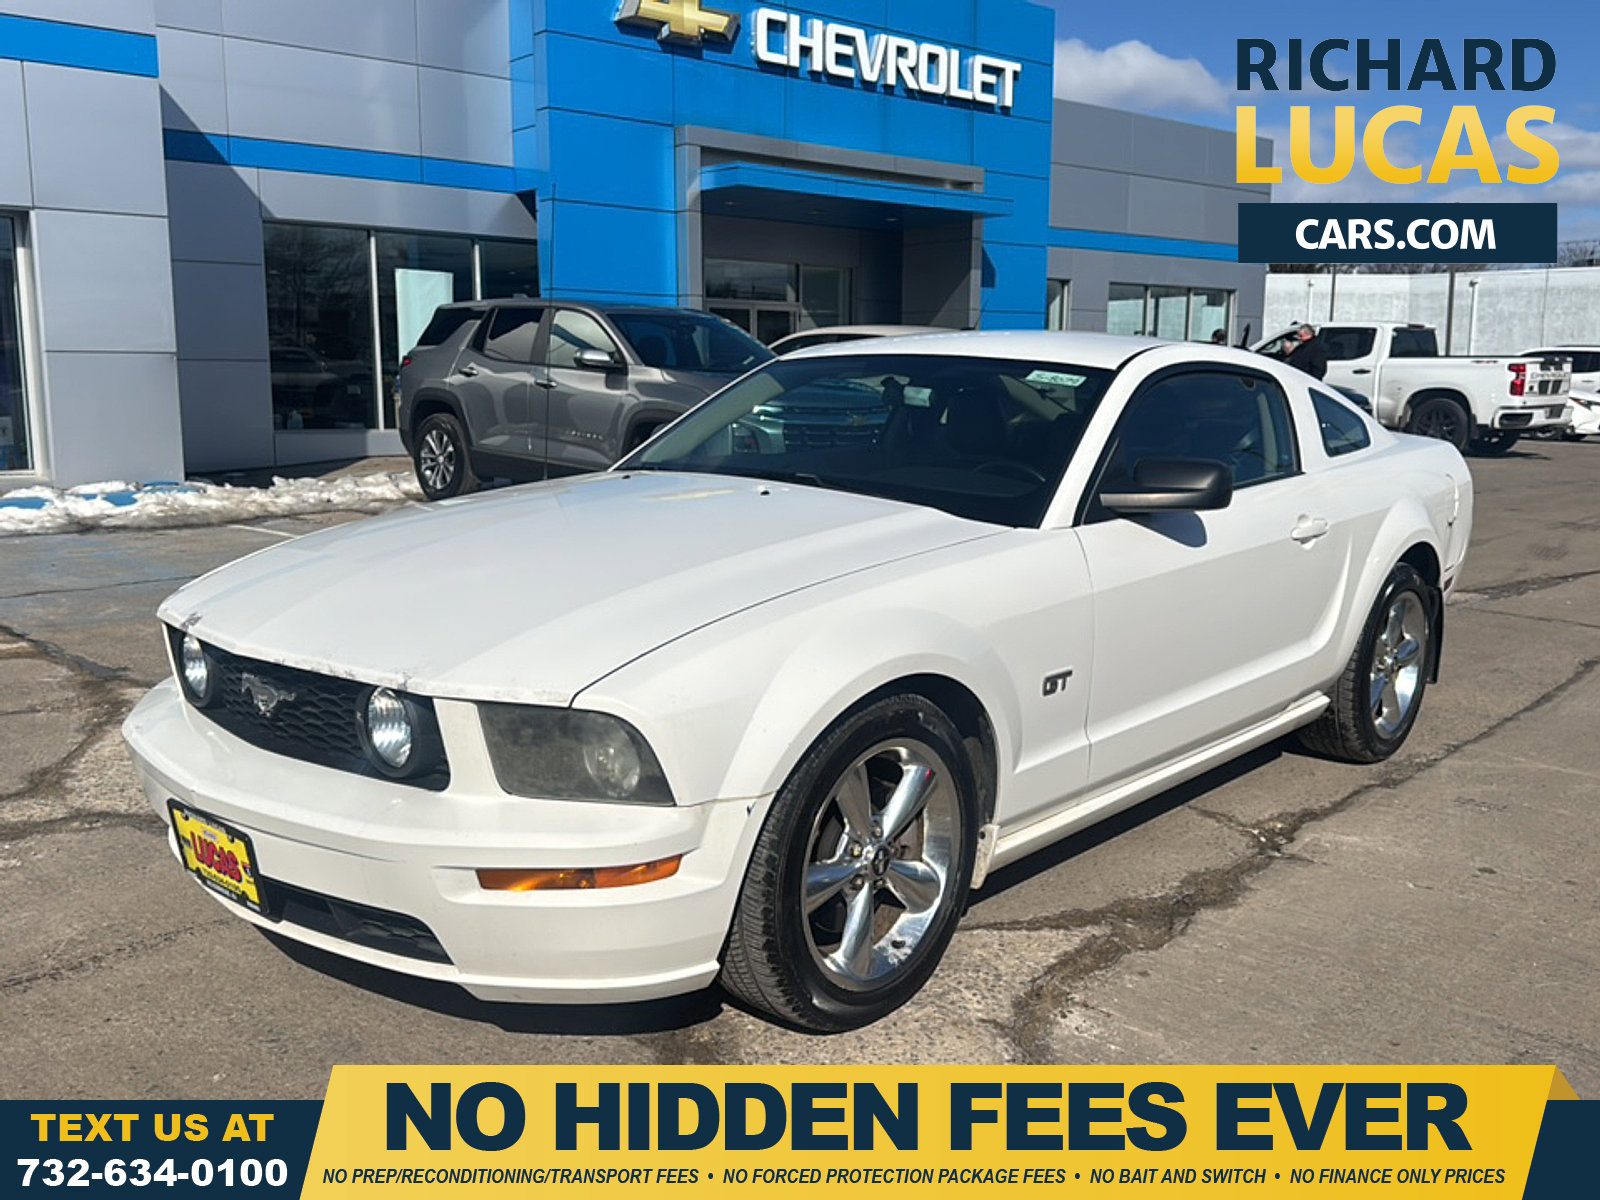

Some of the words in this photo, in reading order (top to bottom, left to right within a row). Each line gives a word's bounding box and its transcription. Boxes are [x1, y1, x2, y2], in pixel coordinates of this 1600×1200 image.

[754, 6, 1022, 108] CHEVROLET
[1042, 669, 1073, 697] GT
[190, 830, 242, 882] LUCAS
